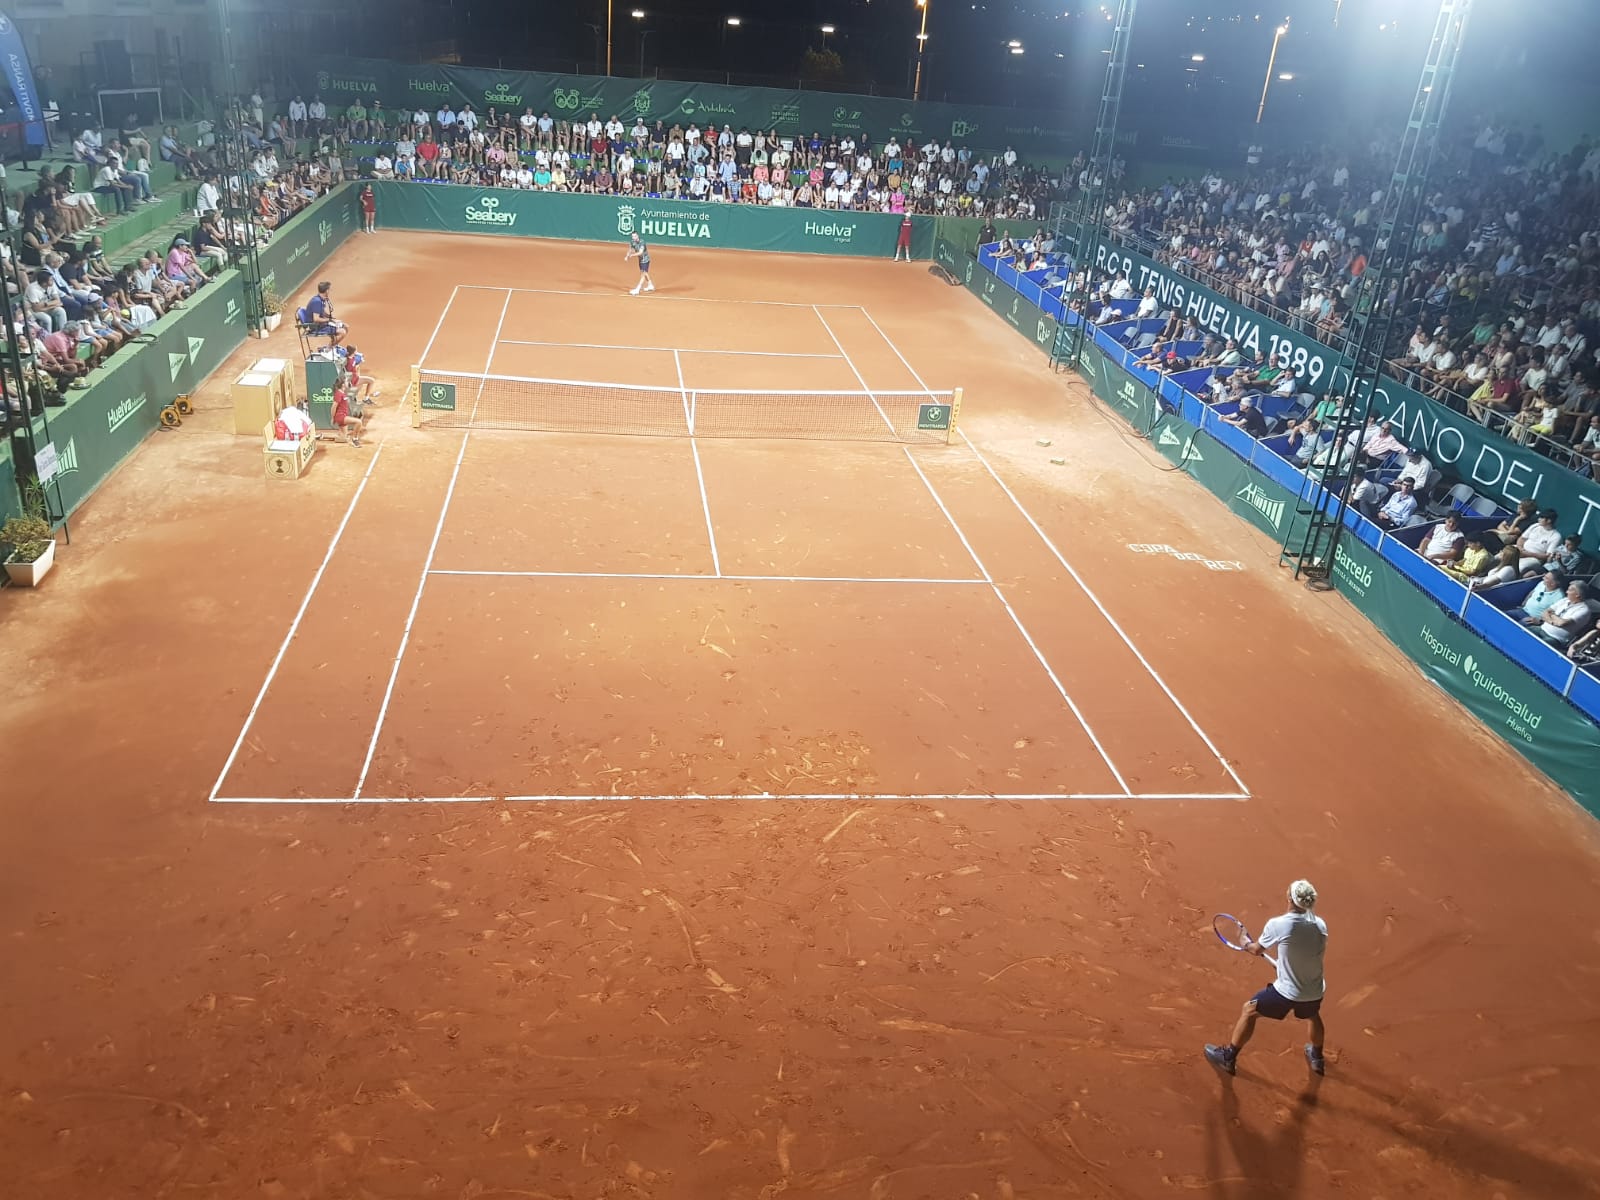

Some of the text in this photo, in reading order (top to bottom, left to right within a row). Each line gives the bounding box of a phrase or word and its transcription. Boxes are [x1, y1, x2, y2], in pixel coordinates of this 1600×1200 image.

[333, 79, 377, 93] HUELVA
[408, 79, 450, 92] Huelva
[484, 90, 522, 106] Seabery
[465, 206, 517, 226] Seabery
[641, 209, 710, 221] Ayuntamiento de
[641, 220, 711, 238] HUELVA
[805, 221, 852, 237] Huelva
[1139, 264, 1185, 310] TENIS
[1185, 291, 1260, 358] HUELVA
[1269, 334, 1325, 387] 1889
[312, 393, 334, 402] Seab
[107, 398, 132, 428] Huelva
[1128, 543, 1244, 571] COPA DEL REY
[1334, 543, 1373, 588] Barceló
[1420, 624, 1542, 730] Hospital quirónsalud
[1506, 715, 1532, 742] Huelva
